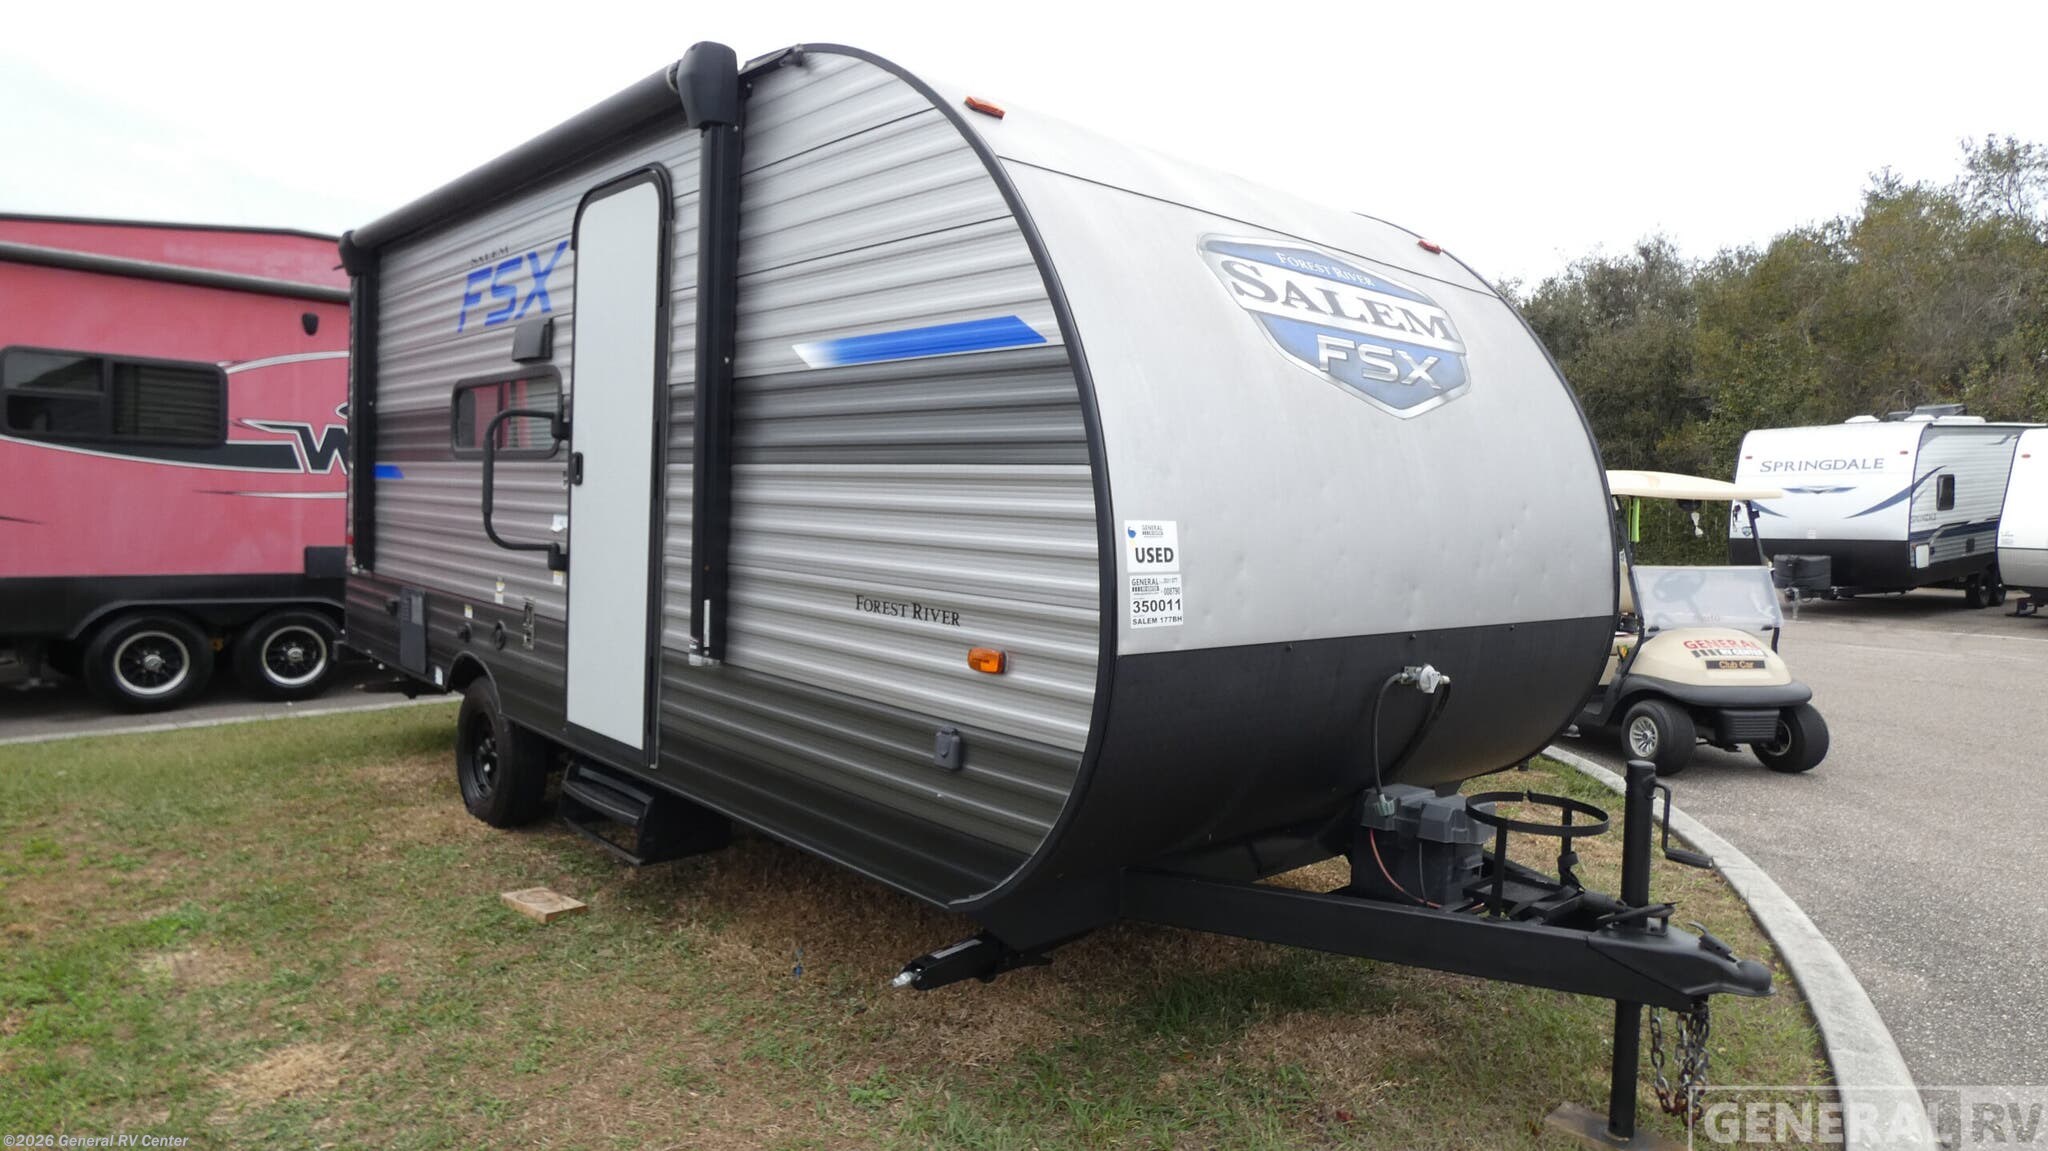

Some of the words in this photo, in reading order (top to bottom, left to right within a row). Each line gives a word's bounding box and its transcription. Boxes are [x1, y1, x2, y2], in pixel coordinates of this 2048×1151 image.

[1276, 252, 1331, 275] FOREST
[1332, 266, 1375, 287] RIVER
[458, 241, 568, 332] FSX
[1221, 259, 1460, 344] SALEM
[1316, 334, 1441, 390] FSX
[1760, 458, 1884, 472] SPRINGDALE
[1135, 547, 1174, 563] USED
[1131, 578, 1158, 586] GENERAL
[856, 595, 909, 617] FOREST
[912, 602, 960, 626] RIVER
[1133, 599, 1181, 613] 350011
[1132, 617, 1158, 625] SALEM
[1683, 639, 1762, 650] GENERAL
